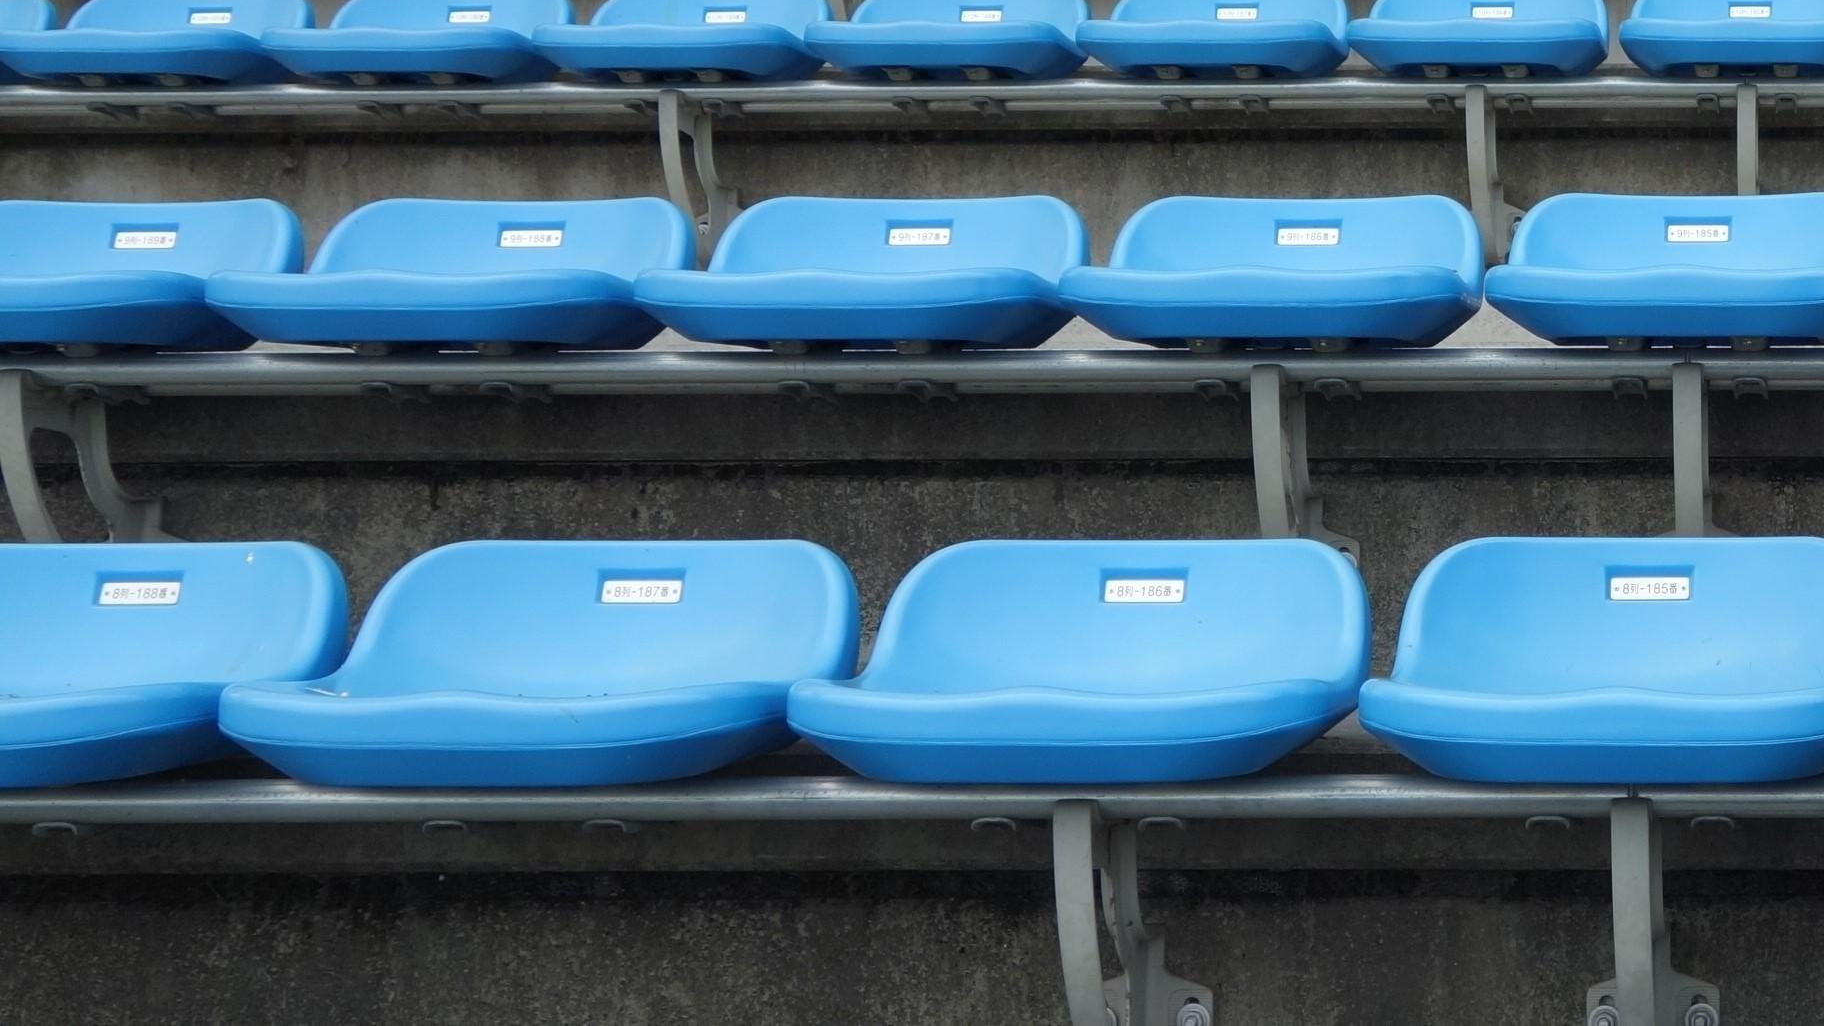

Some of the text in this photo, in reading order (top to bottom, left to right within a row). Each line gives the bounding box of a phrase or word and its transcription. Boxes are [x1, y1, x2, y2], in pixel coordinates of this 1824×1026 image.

[112, 586, 168, 600] 8列-188番
[613, 585, 670, 599] 8列-187番
[1116, 584, 1172, 598] 8列-186番
[1622, 582, 1678, 596] 8列-185番
